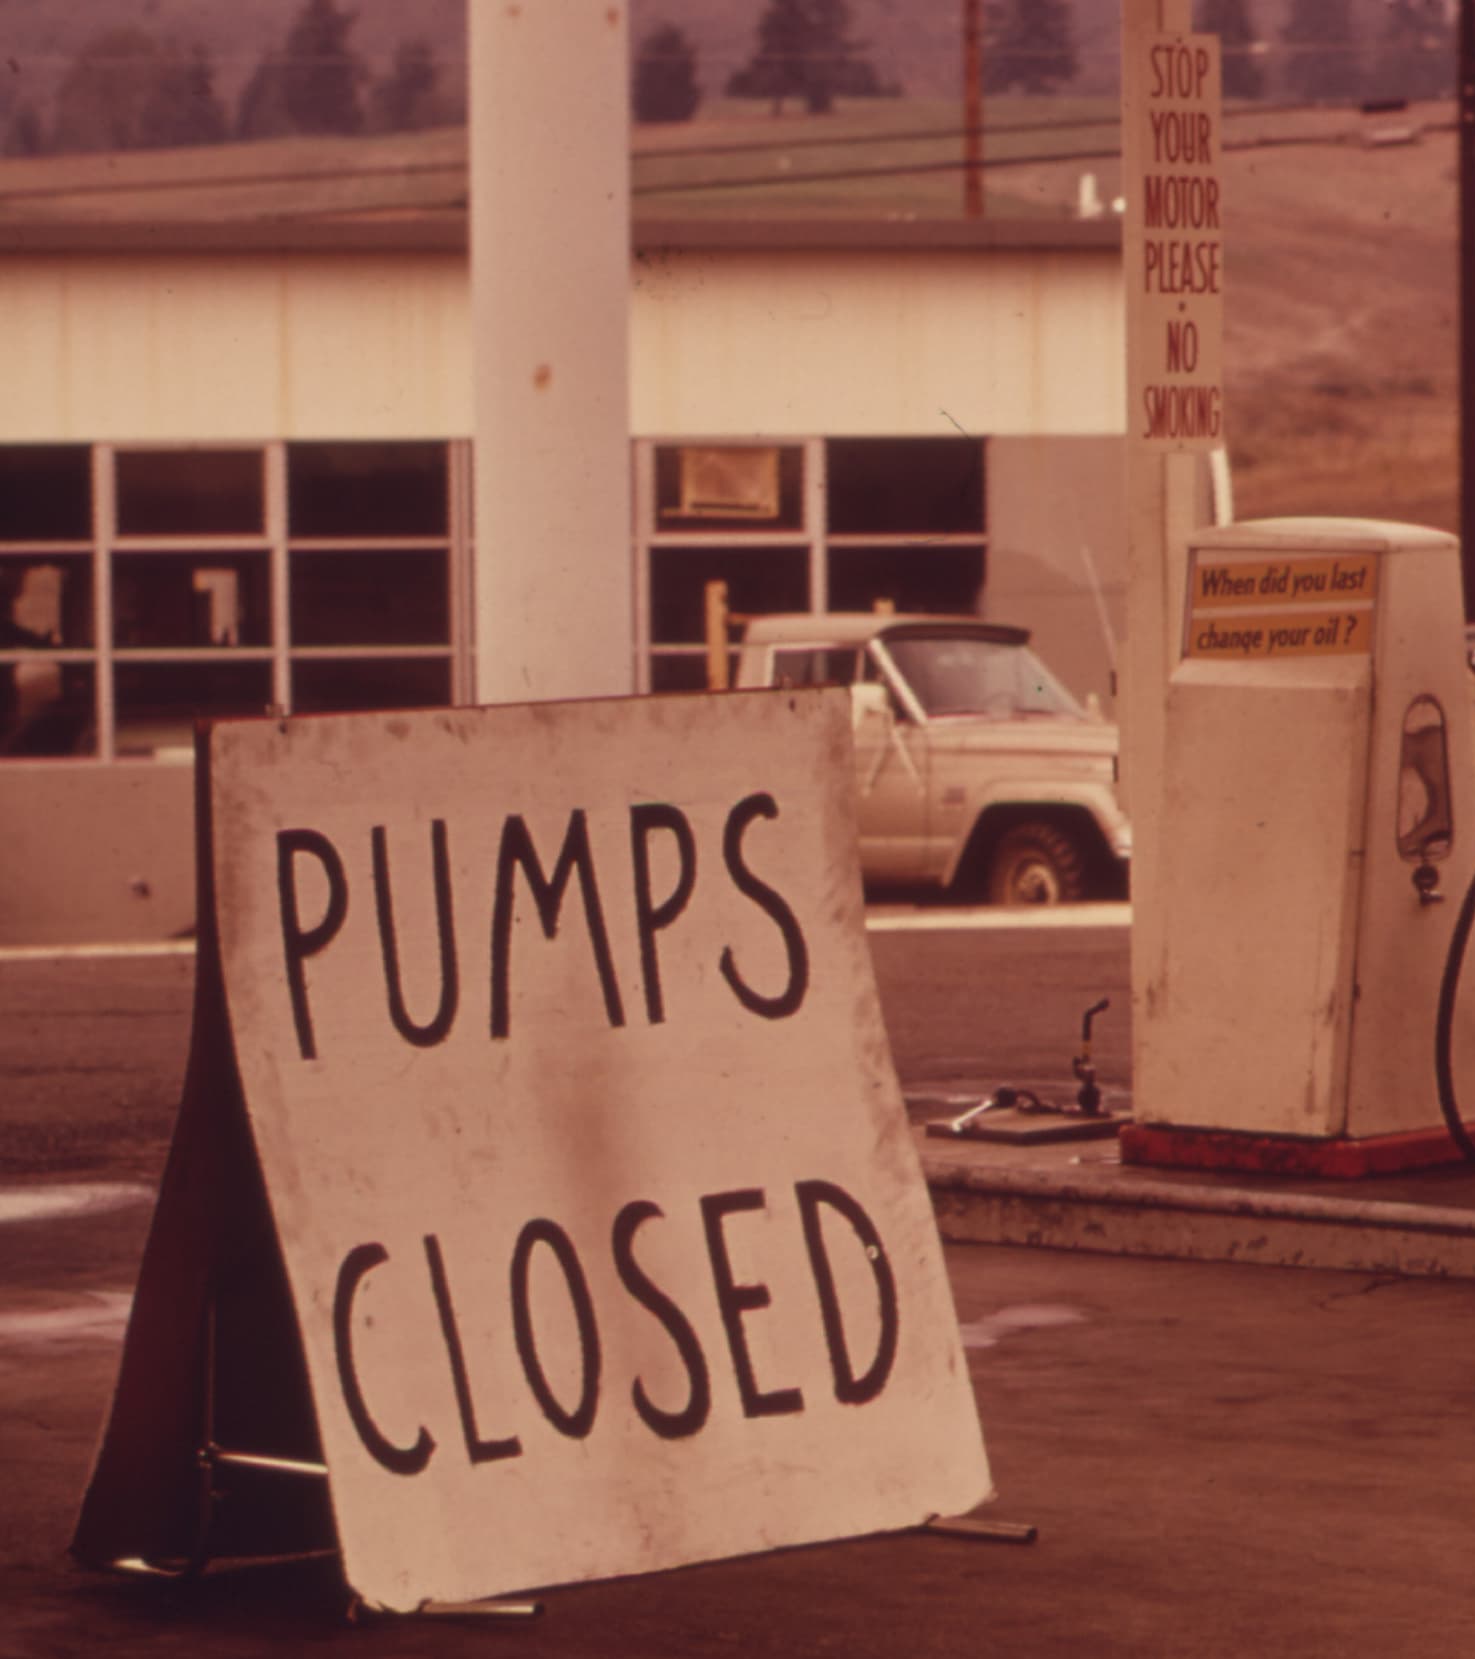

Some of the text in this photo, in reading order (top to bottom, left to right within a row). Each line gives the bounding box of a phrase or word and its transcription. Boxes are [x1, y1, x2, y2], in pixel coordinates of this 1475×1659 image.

[1150, 45, 1209, 98] STOP
[1150, 111, 1211, 164] YOUR
[1144, 176, 1219, 229] MOTOR
[1144, 241, 1220, 294] PLEASE
[1166, 321, 1197, 373] NO
[1143, 385, 1220, 438] SMOKING
[1202, 563, 1366, 597] When did you last
[1197, 616, 1358, 655] change your oil ?
[276, 792, 809, 1060] PUMPS
[333, 1179, 899, 1476] CLOSED
